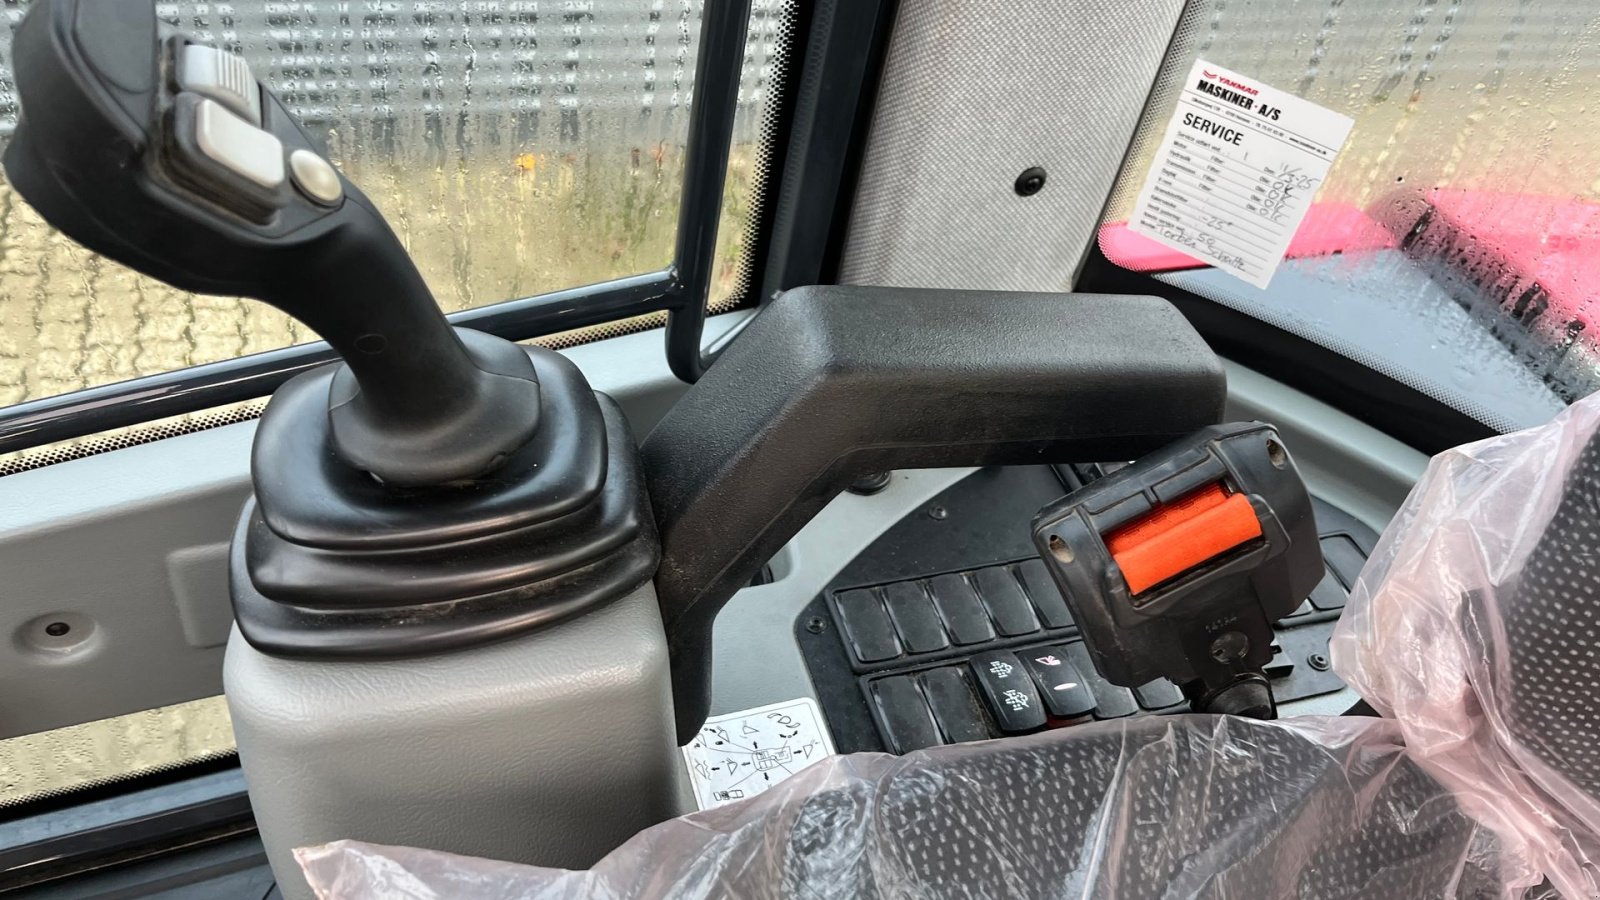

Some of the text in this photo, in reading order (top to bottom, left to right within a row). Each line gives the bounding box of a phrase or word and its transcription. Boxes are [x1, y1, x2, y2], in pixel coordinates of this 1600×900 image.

[1196, 79, 1254, 111] MASKINER
[1258, 104, 1282, 121] A/S
[1218, 76, 1259, 97] YANMAR
[1183, 112, 1244, 146] SERVICE
